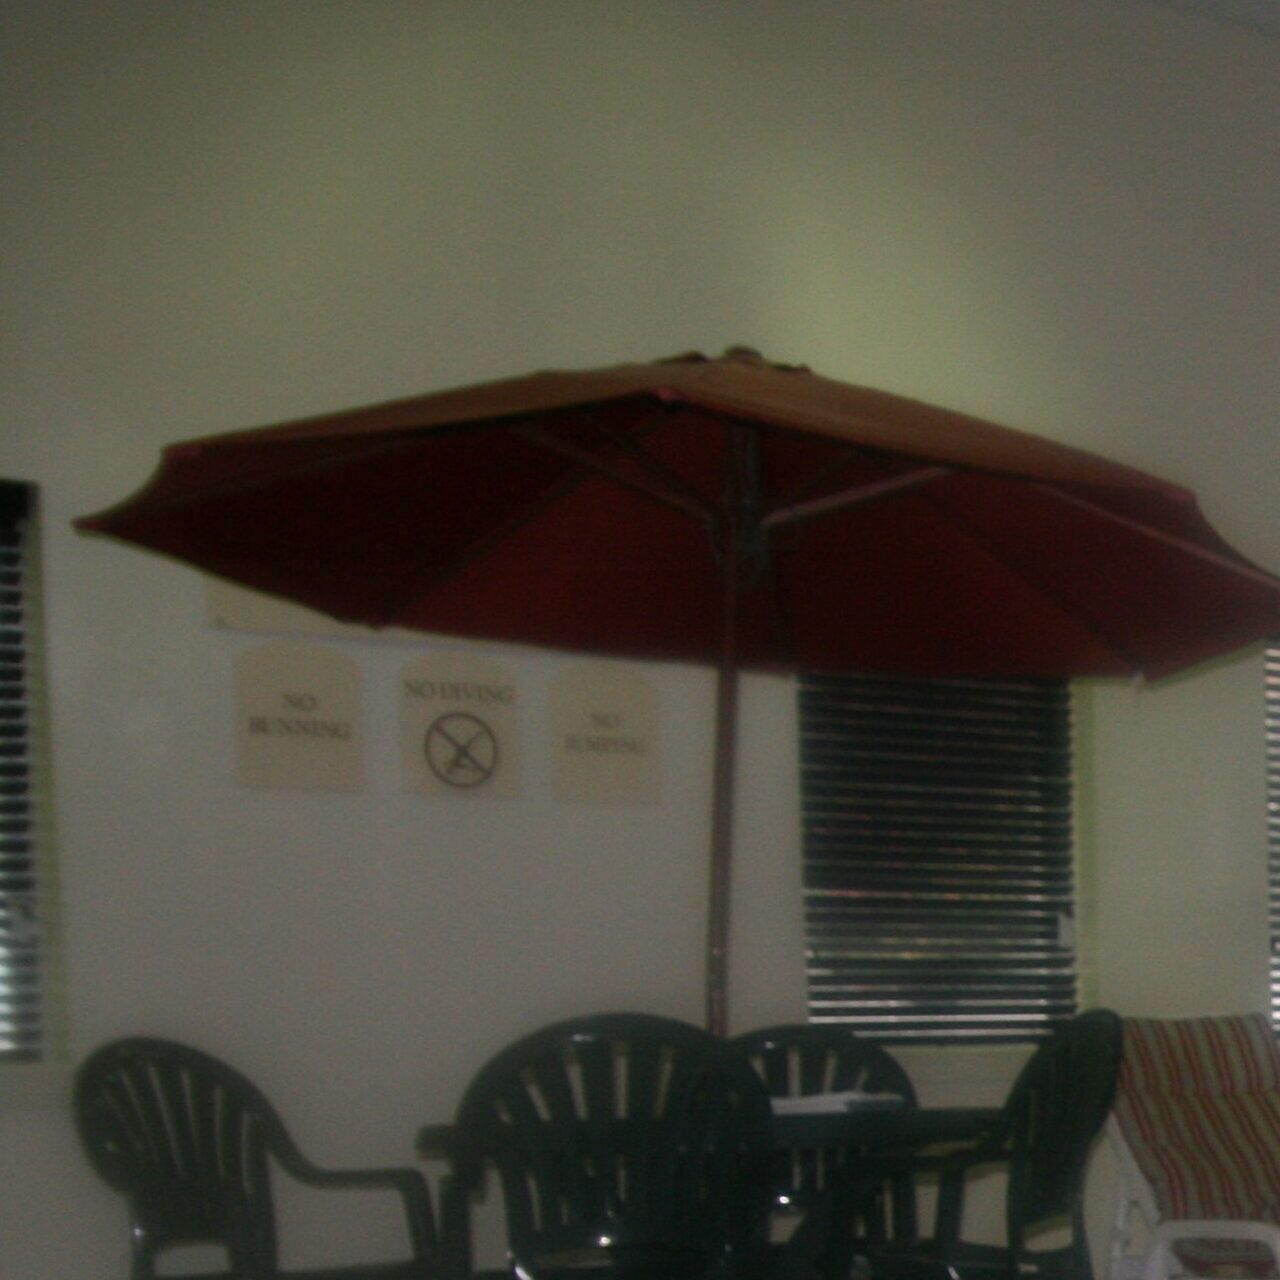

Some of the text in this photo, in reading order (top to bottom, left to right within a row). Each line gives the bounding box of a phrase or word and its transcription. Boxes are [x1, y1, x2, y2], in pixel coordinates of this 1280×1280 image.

[283, 692, 317, 711] NO
[404, 680, 514, 704] NO DIVING
[248, 716, 351, 741] RUNNING
